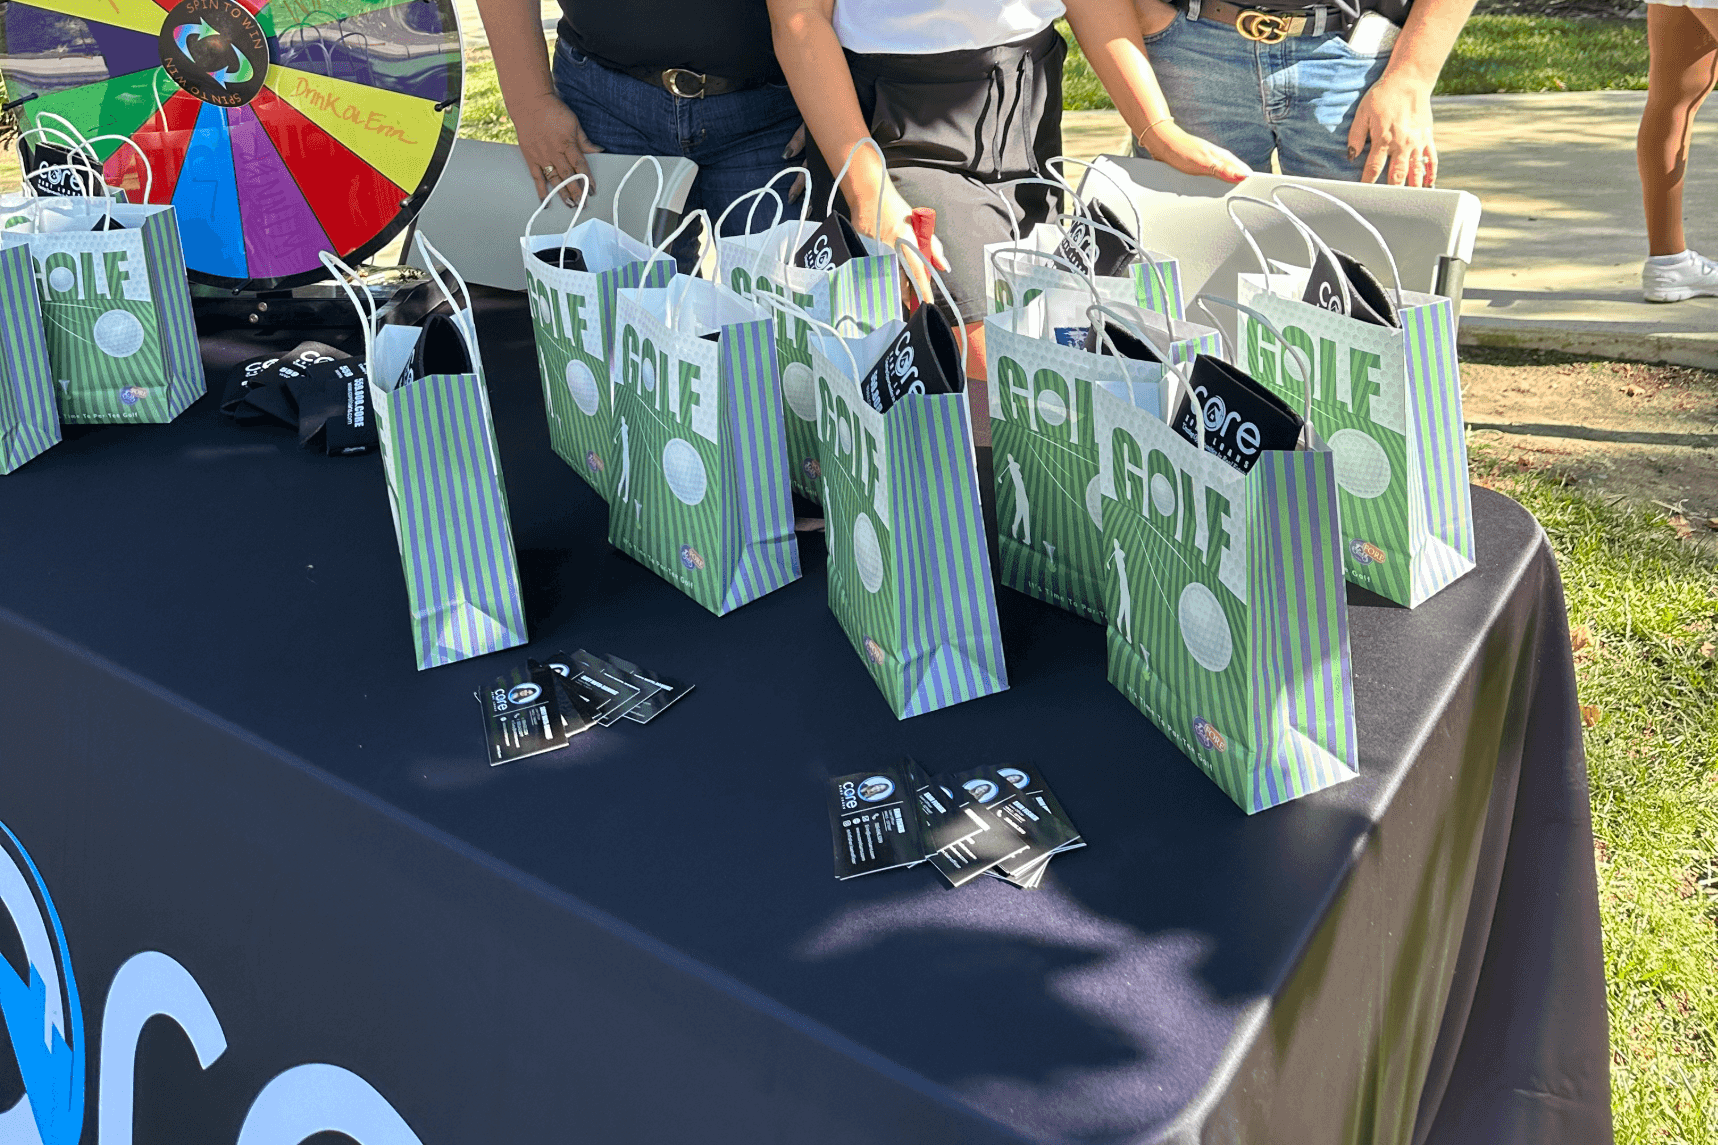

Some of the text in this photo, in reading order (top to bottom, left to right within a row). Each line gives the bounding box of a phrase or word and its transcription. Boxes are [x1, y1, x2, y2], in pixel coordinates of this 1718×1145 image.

[186, 0, 263, 49] SPIN TO WIN
[164, 57, 242, 105] SPIN TO WIN
[526, 267, 587, 351] GOLF
[622, 323, 701, 430] GOLF
[998, 355, 1099, 455] GOL
[1247, 315, 1381, 421] GOLF
[818, 376, 879, 505] GOLF
[1191, 385, 1261, 455] core
[1112, 426, 1232, 577] GOLF
[493, 688, 508, 712] core
[842, 781, 858, 810] core
